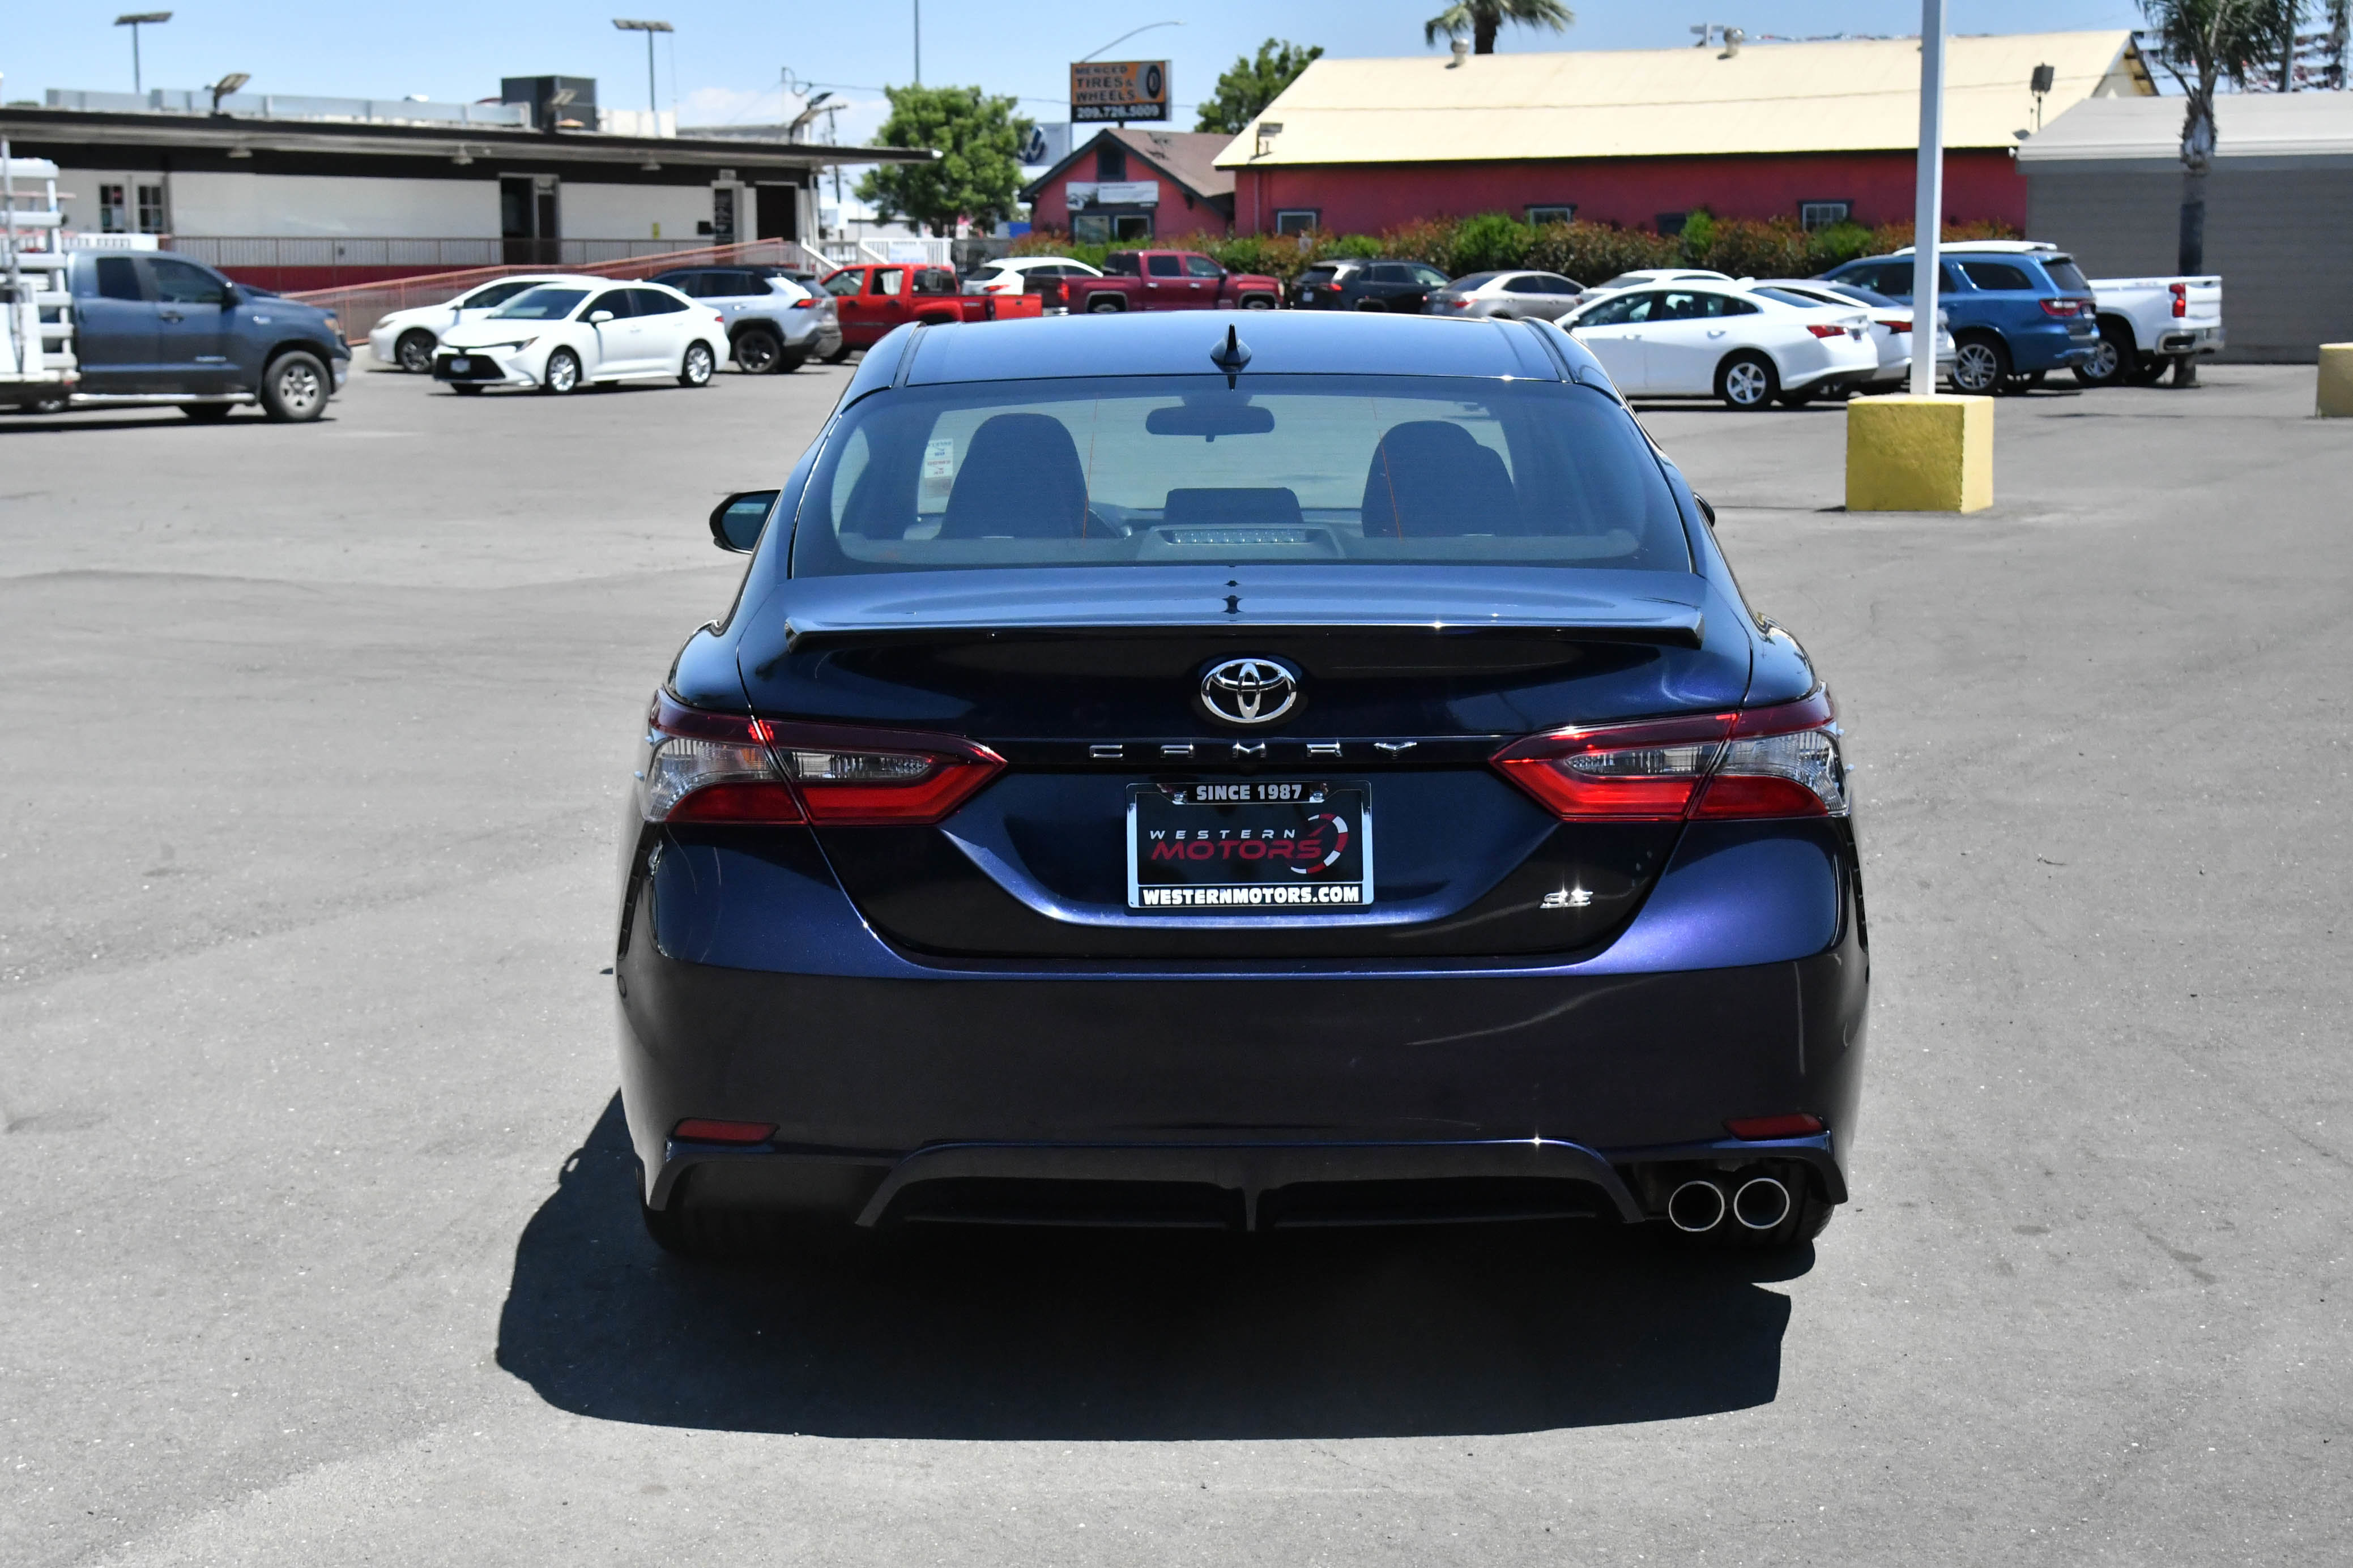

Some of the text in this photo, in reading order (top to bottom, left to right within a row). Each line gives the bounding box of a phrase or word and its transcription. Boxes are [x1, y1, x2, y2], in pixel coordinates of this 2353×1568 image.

[1075, 65, 1128, 74] MERCED
[1077, 76, 1134, 87] TIRES &
[1077, 89, 1136, 101] WHEELS
[1089, 742, 1417, 758] CAMRY
[1196, 784, 1302, 801] SINCE 1987
[1150, 829, 1295, 840] WESTERN
[1151, 839, 1323, 860] MOTORS
[1143, 886, 1359, 905] WESTERNMOTORS.COM
